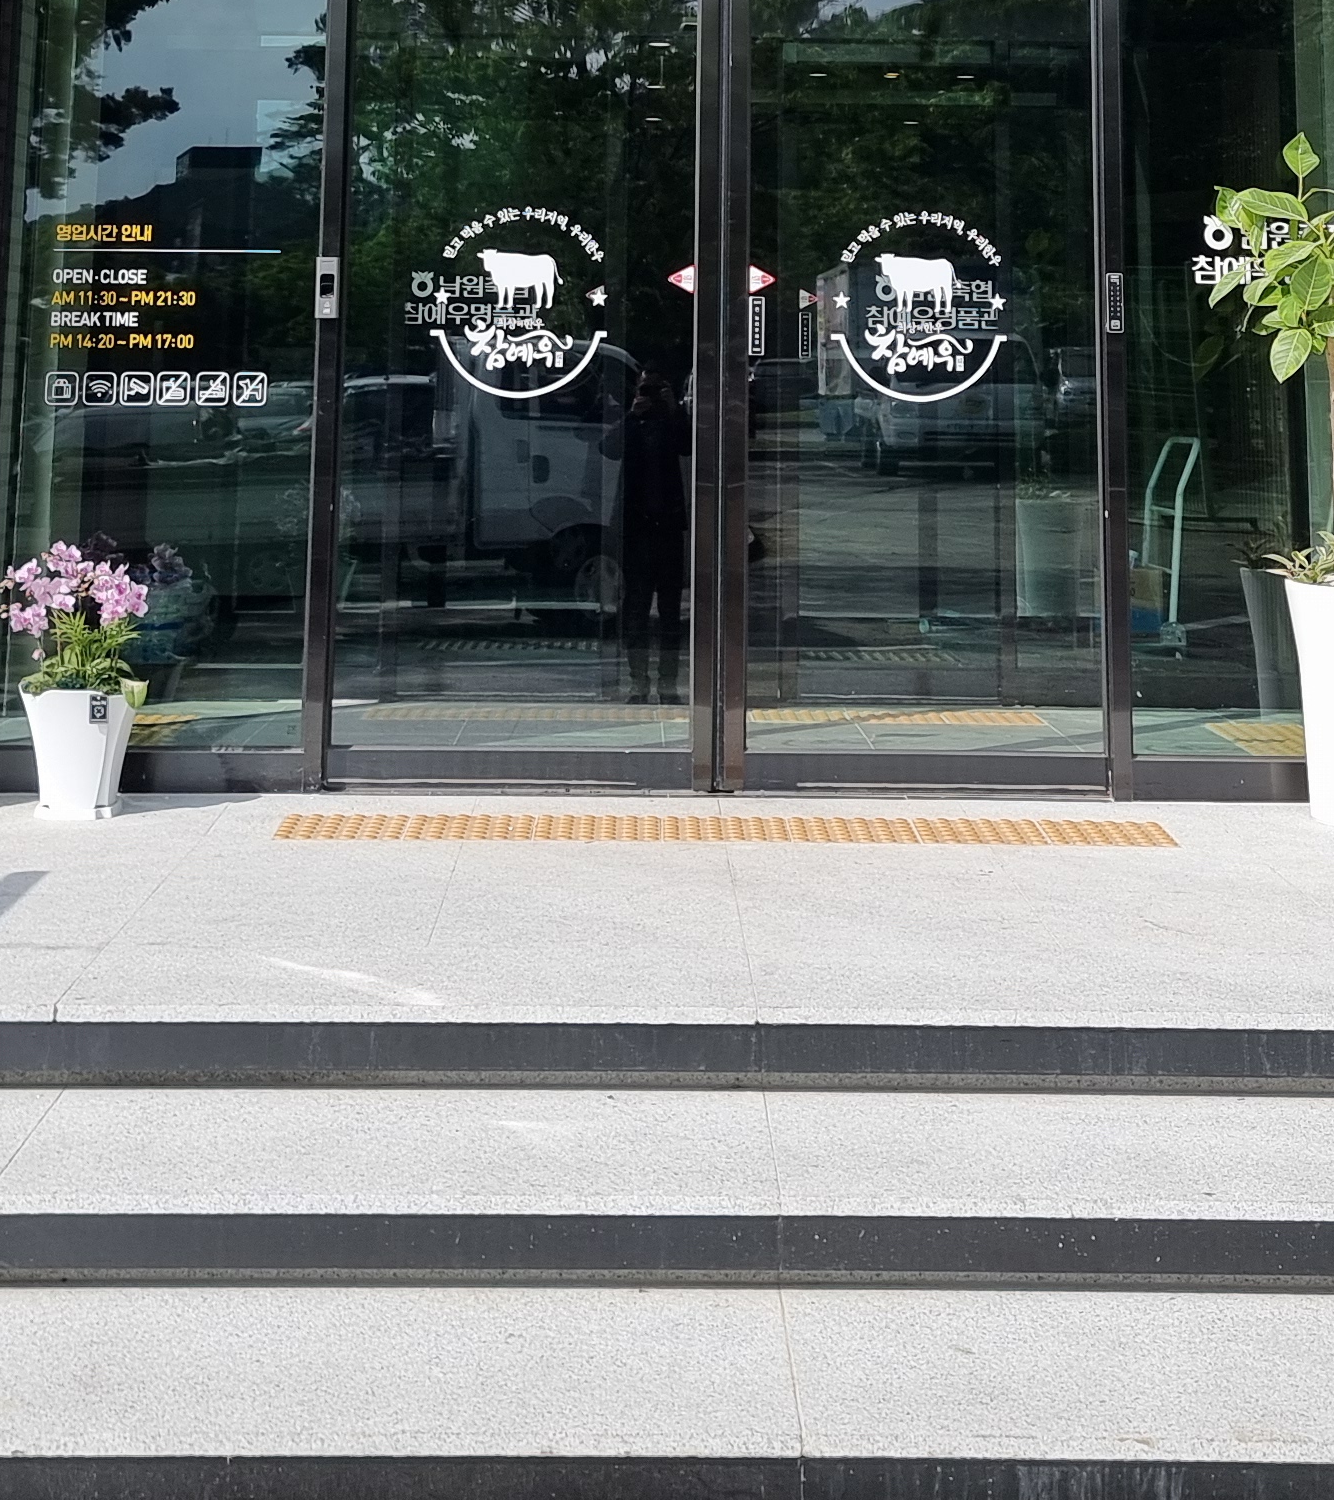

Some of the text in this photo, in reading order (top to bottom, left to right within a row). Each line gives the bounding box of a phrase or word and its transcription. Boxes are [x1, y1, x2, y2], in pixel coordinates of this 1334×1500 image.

[56, 224, 153, 242] 영업시간 안내
[442, 237, 464, 259] 믿고
[483, 214, 496, 228] 수
[497, 208, 521, 225] 있는
[570, 224, 605, 263] 우리한우
[840, 241, 862, 264] 믿고
[880, 218, 893, 232] 수
[893, 212, 917, 229] 있는
[966, 228, 1003, 267] 우리한우
[51, 291, 74, 306] AM
[78, 291, 116, 306] 11:30
[131, 291, 154, 306] PM
[157, 291, 196, 306] 21:30
[51, 312, 139, 327] BREAK TIME
[50, 334, 72, 349] PM
[77, 334, 114, 349] 14:20
[129, 334, 152, 349] PM
[156, 334, 194, 350] 17:00
[464, 320, 554, 371] 참예우
[864, 324, 955, 375] 참예우
